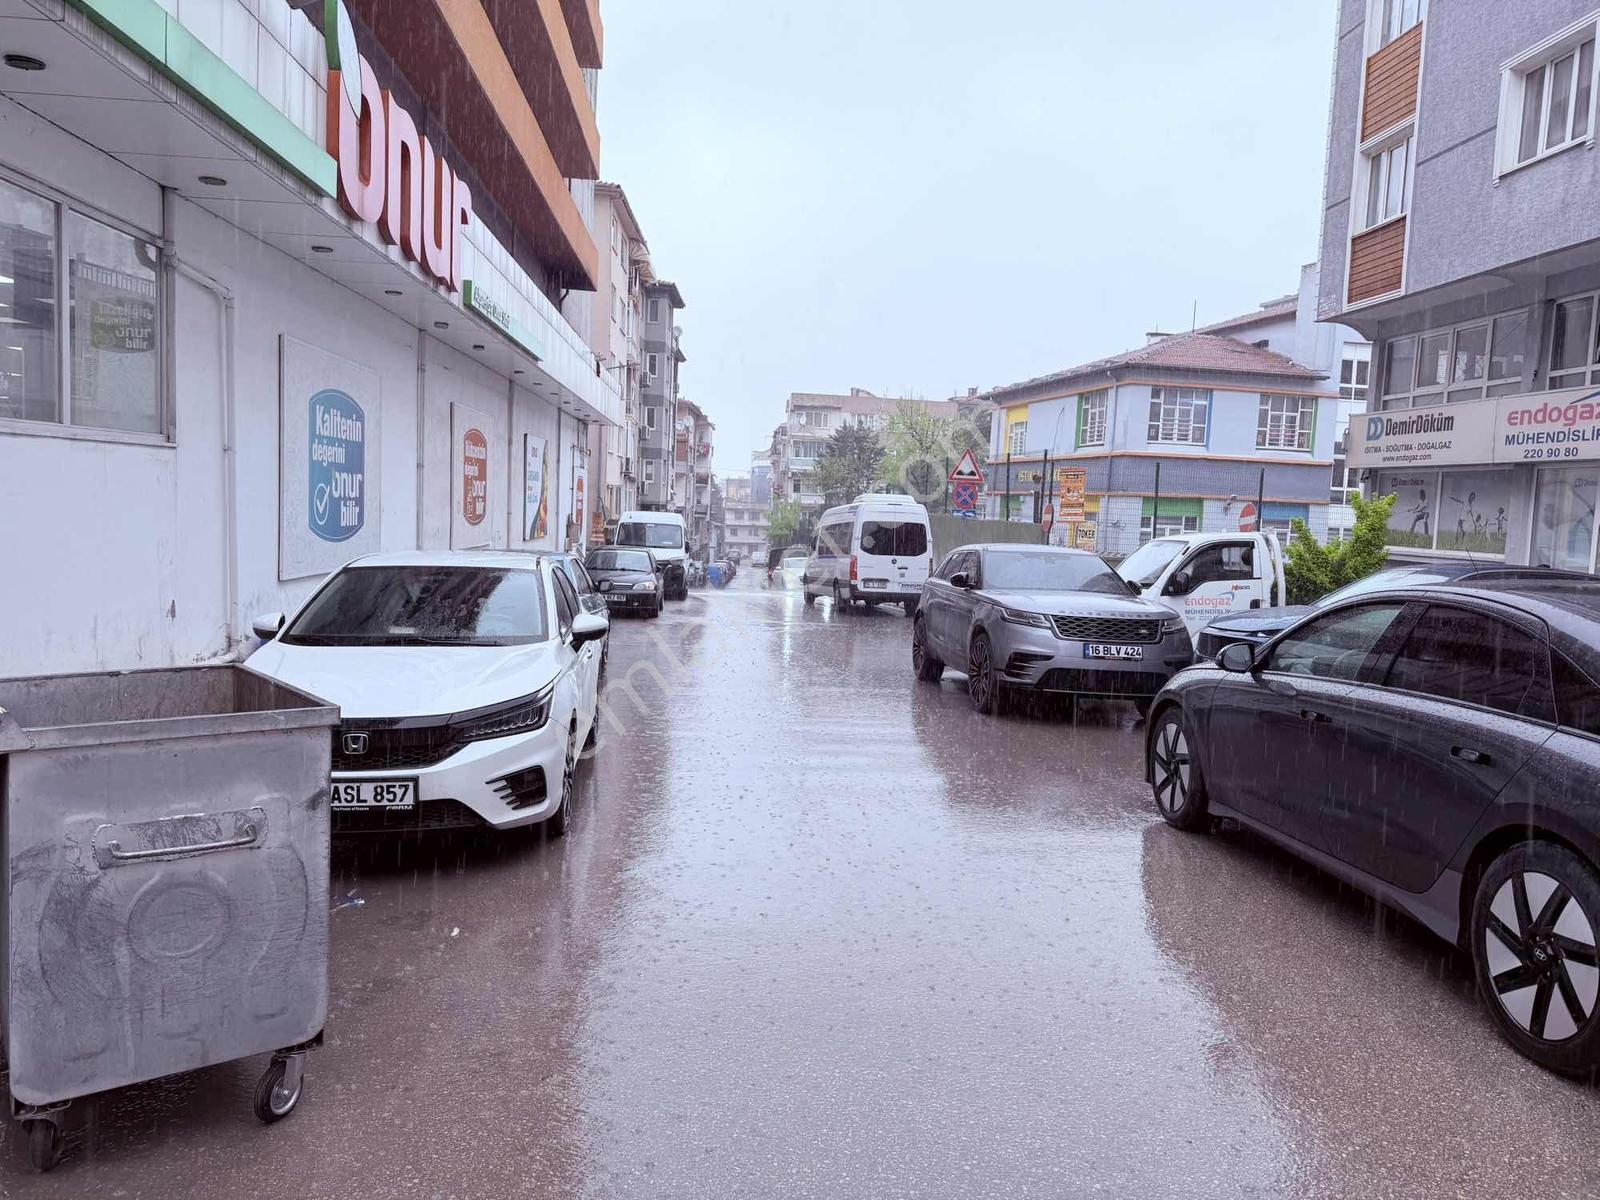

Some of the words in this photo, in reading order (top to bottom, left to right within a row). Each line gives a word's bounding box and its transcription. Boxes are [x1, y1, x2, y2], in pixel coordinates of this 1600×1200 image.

[316, 404, 362, 442] Kalitenin
[1385, 412, 1454, 436] DemirDöküm
[312, 438, 346, 466] değerini
[1523, 448, 1543, 459] 220
[1547, 447, 1561, 458] 90
[1564, 446, 1578, 457] 80
[331, 470, 363, 498] onur
[340, 500, 360, 527] bilir
[1090, 645, 1101, 655] 16
[1103, 646, 1122, 656] BLV
[1124, 647, 1141, 657] 424
[331, 785, 368, 803] ASL
[373, 784, 410, 803] 857
